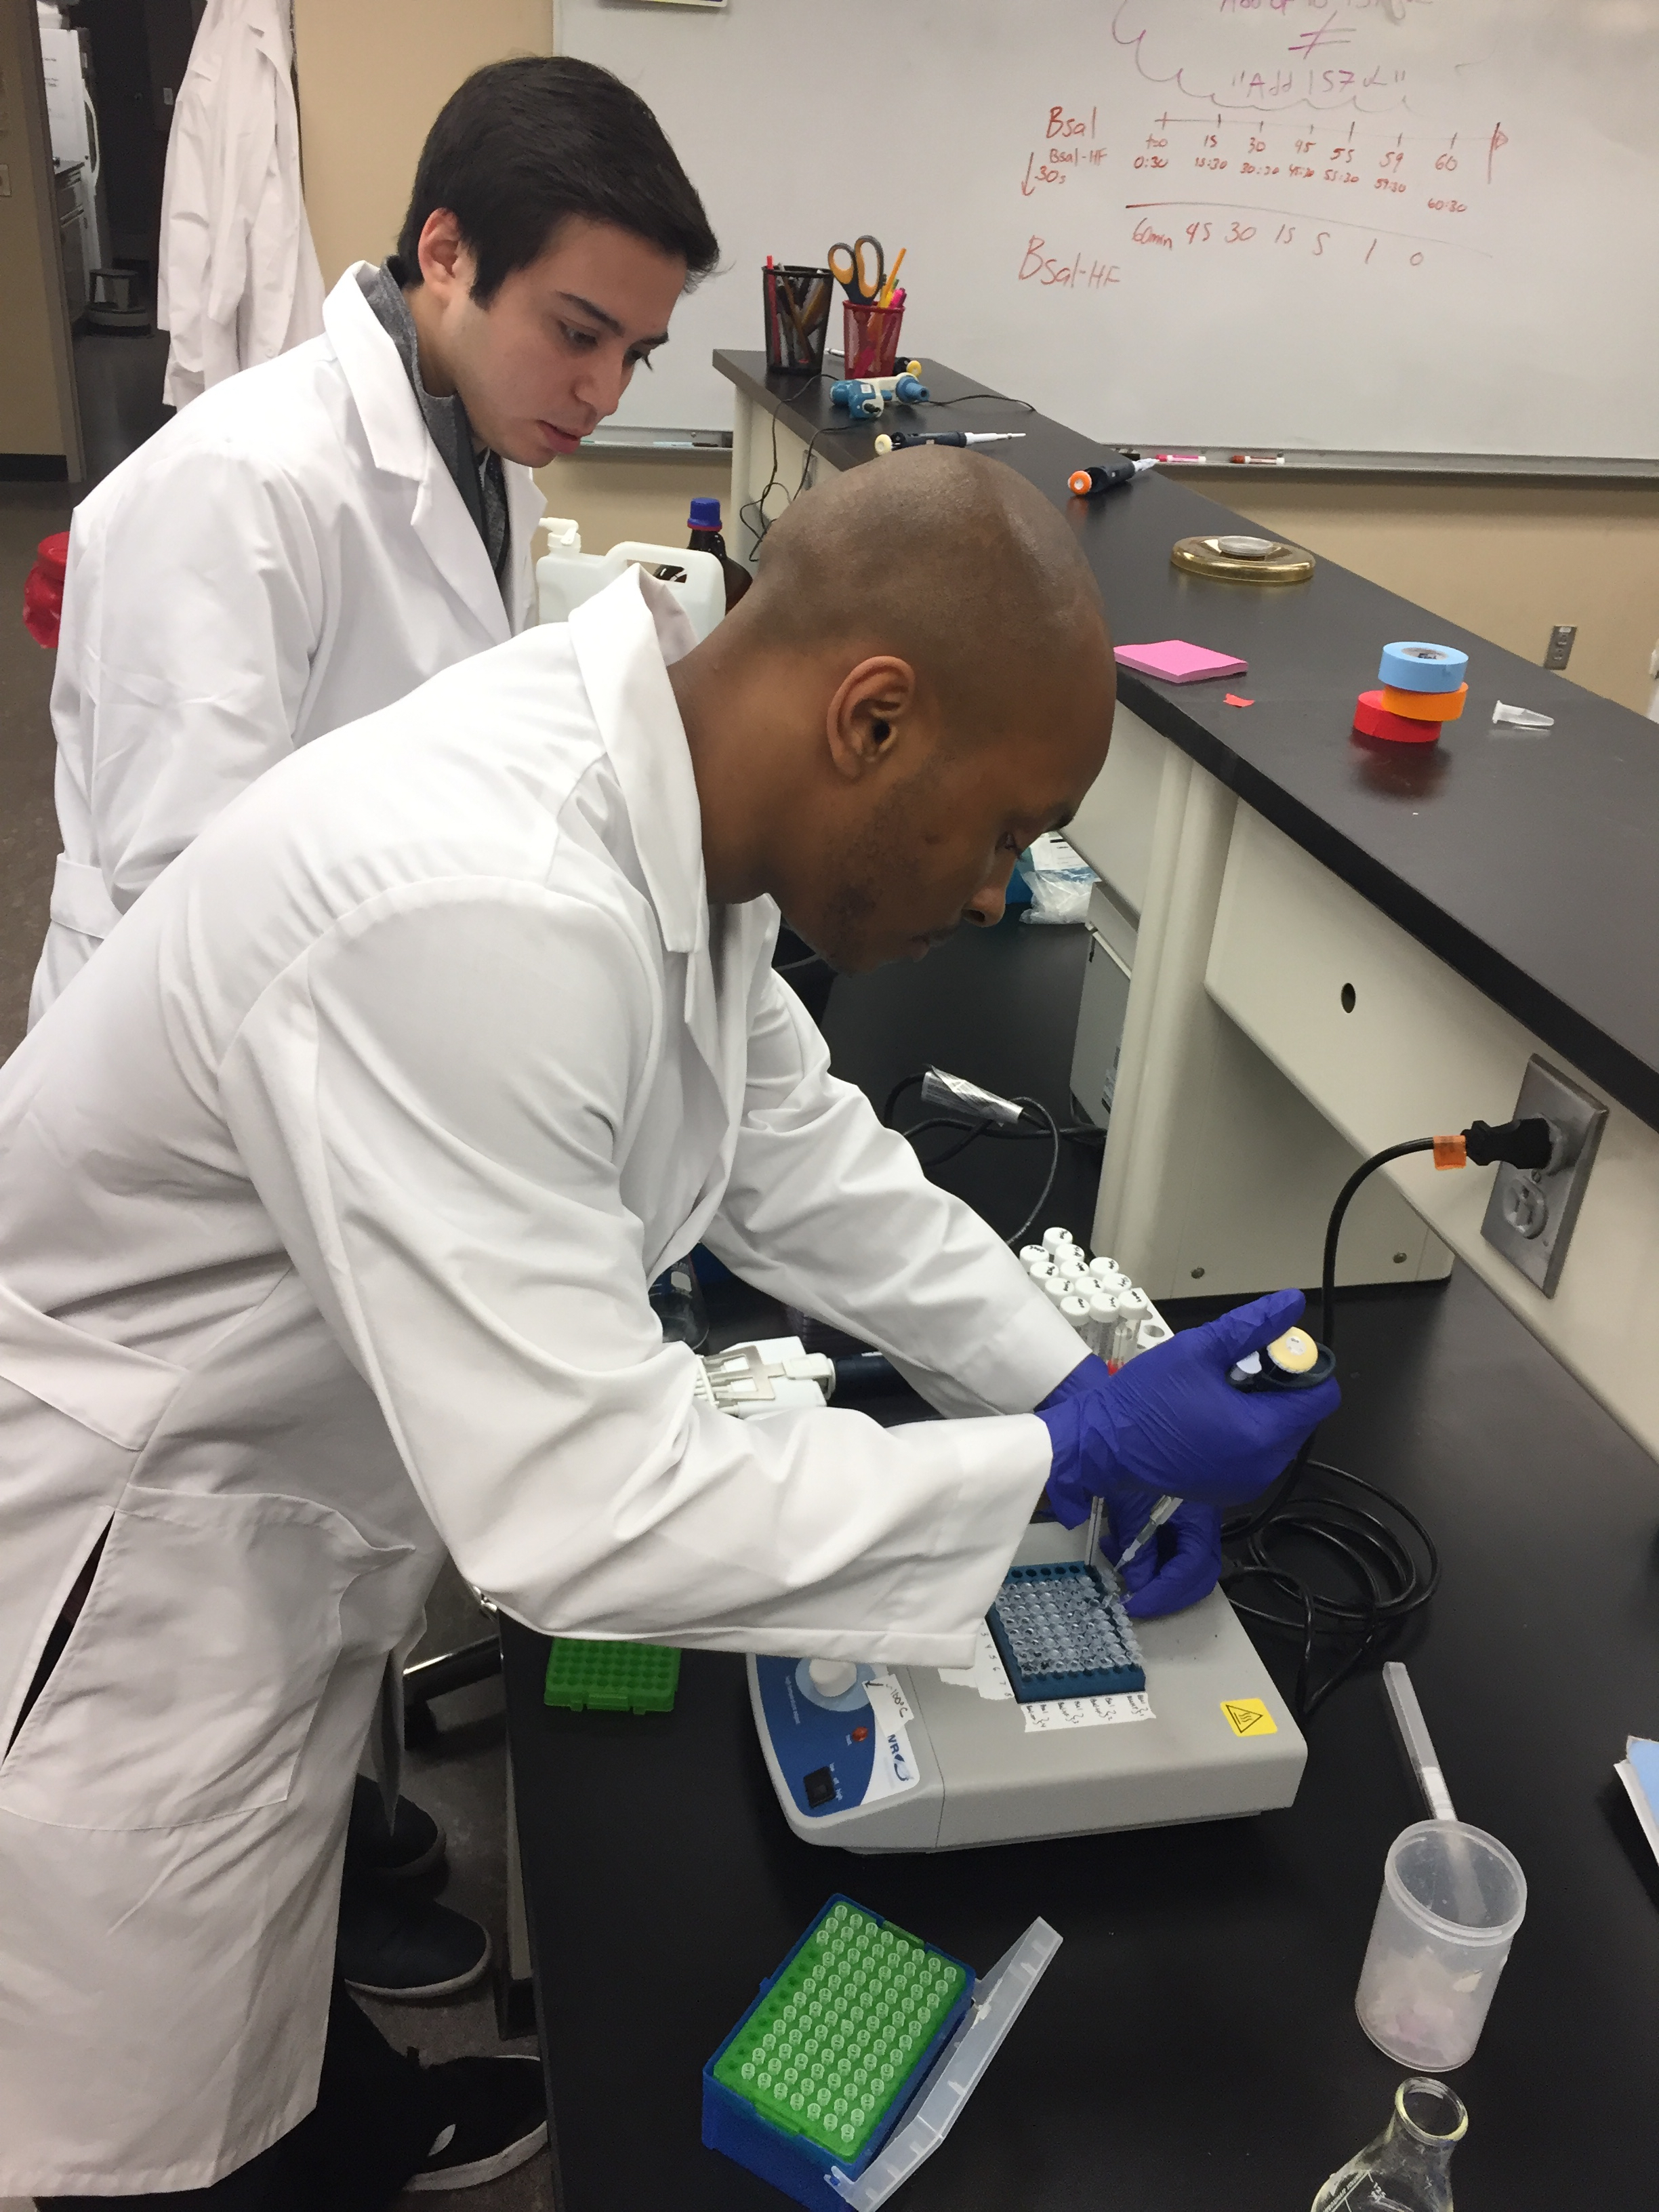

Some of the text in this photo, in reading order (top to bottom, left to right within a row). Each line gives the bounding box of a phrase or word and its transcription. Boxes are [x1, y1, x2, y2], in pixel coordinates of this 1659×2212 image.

[1308, 69, 1355, 95] 157
[1204, 134, 1218, 148] 15
[1248, 137, 1267, 153] 30
[1295, 139, 1317, 154] 45
[1378, 151, 1404, 173] 59
[1435, 153, 1458, 171] 60
[1186, 222, 1212, 244] 45
[1224, 221, 1257, 243] 30
[1275, 224, 1296, 244] 15
